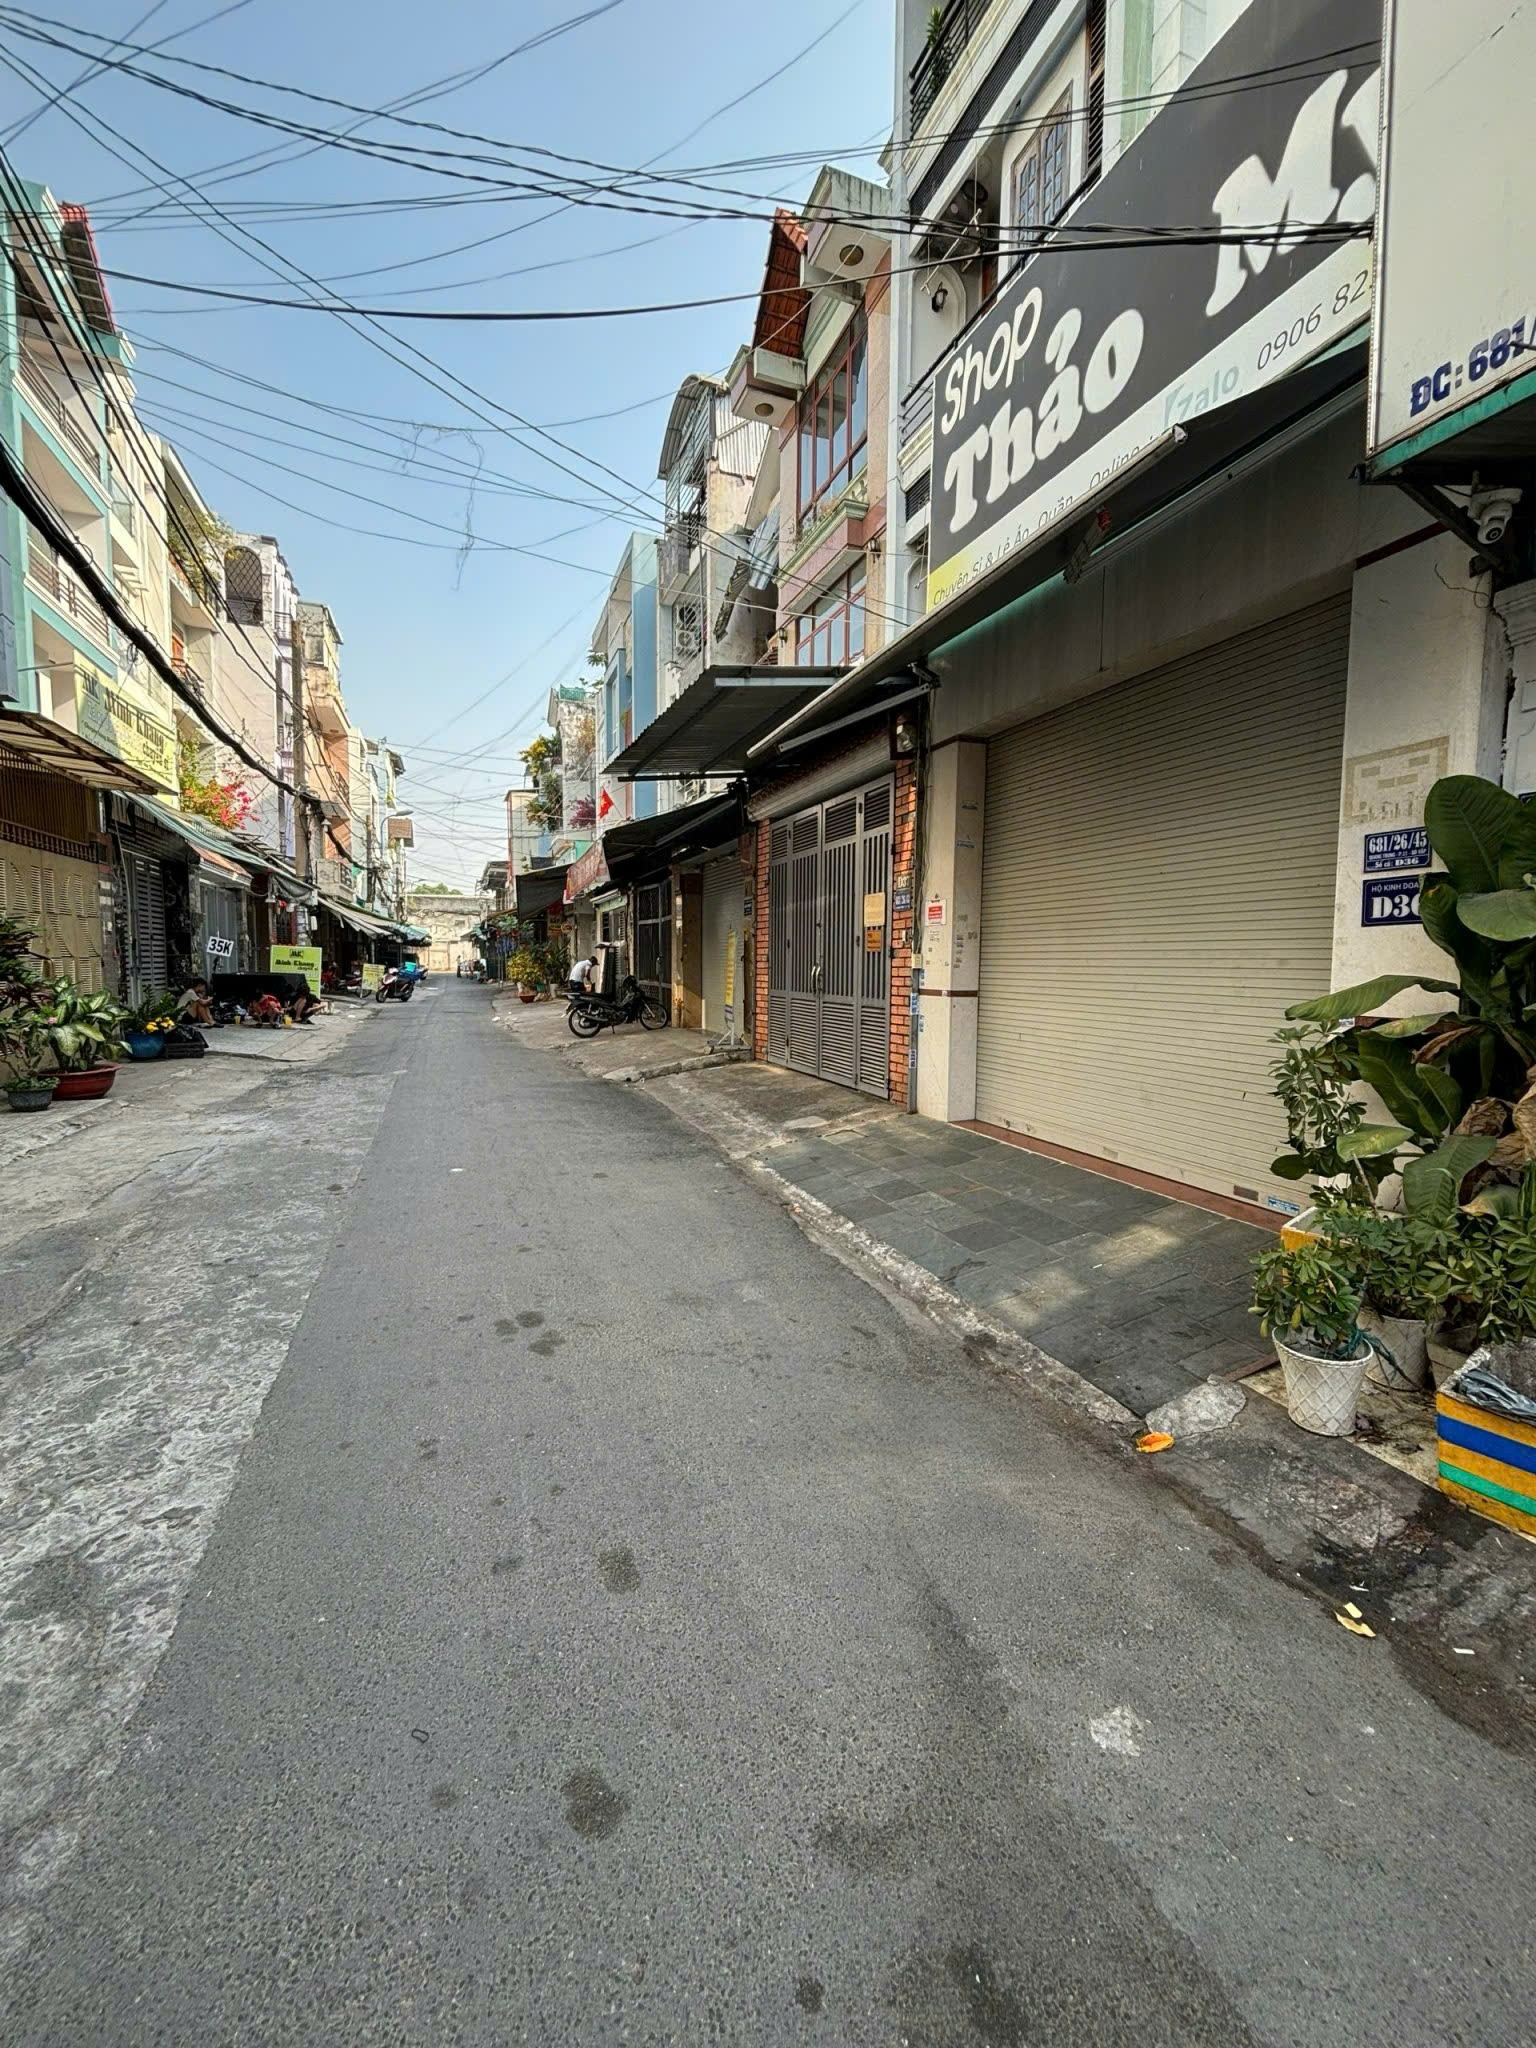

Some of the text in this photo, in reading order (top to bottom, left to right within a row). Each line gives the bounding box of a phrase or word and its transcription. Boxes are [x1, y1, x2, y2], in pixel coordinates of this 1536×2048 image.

[1257, 269, 1372, 370] 0906 82
[941, 287, 1042, 434] Shop
[944, 308, 1144, 534] Thảo
[1368, 831, 1428, 853] 681/26/45
[1395, 857, 1419, 866] D36
[1371, 880, 1420, 894] HỘ KINH DOA
[208, 938, 232, 956] 35K
